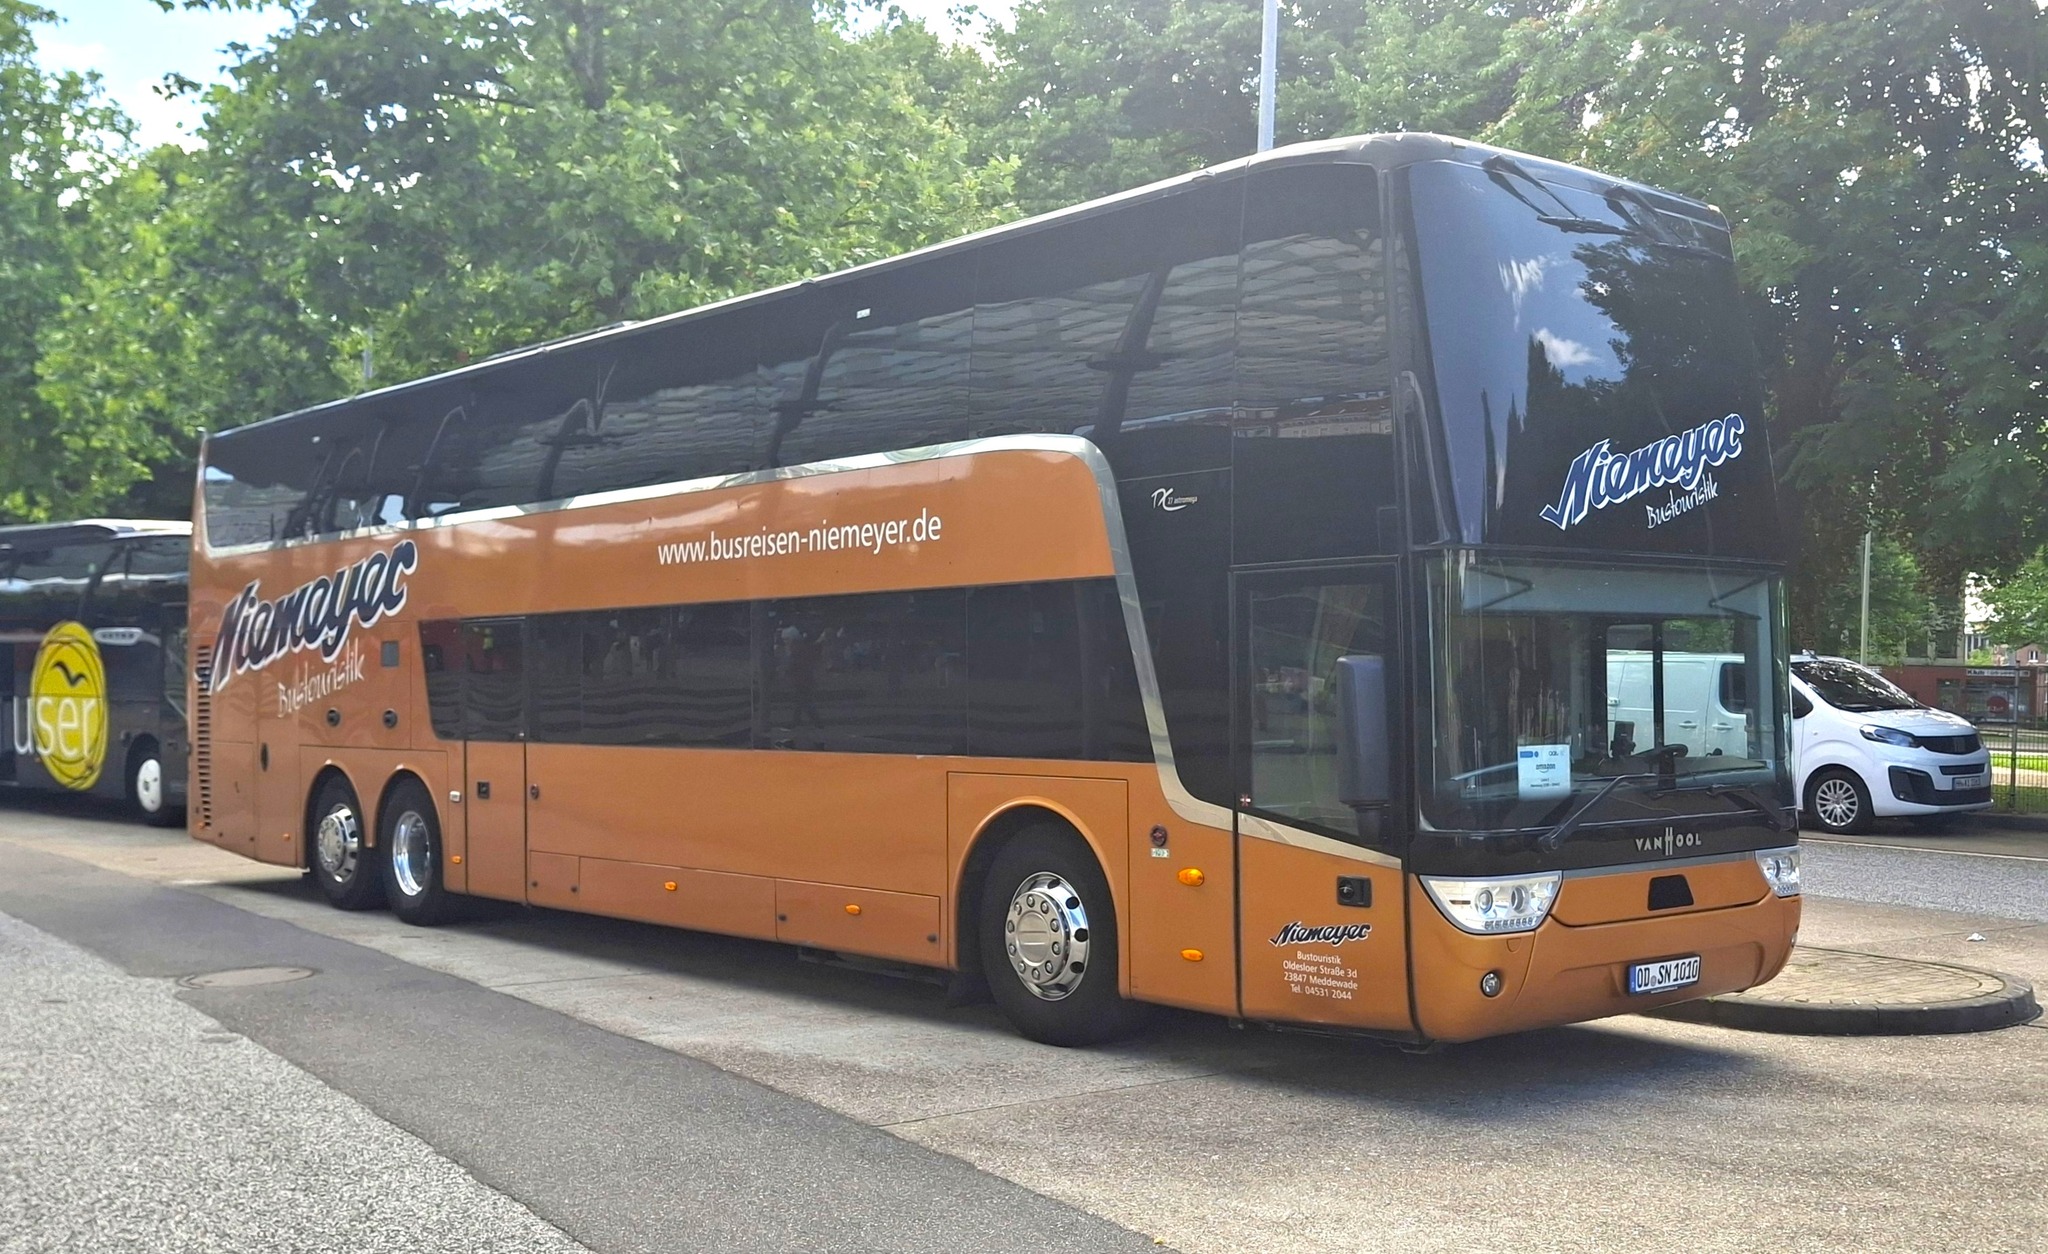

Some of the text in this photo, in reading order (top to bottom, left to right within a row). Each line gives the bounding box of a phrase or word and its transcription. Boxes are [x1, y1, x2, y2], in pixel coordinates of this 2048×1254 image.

[1539, 413, 1745, 531] Niemeyer
[1645, 472, 1719, 529] Bustouristik
[658, 507, 942, 566] www.busreisen-niemeyer.de
[194, 539, 418, 696] Niemeyer
[277, 636, 365, 718] Bustouristik
[13, 695, 97, 757] user
[1268, 921, 1372, 947] Niemeyer
[1282, 960, 1358, 978] Oldesloer Straße 3d
[1296, 950, 1342, 965] Bustouristik
[1637, 959, 1698, 989] OD SN 1010
[1283, 971, 1358, 990] 23847 Meddewade
[1304, 985, 1329, 997] 04531
[1331, 989, 1352, 1000] 2044
